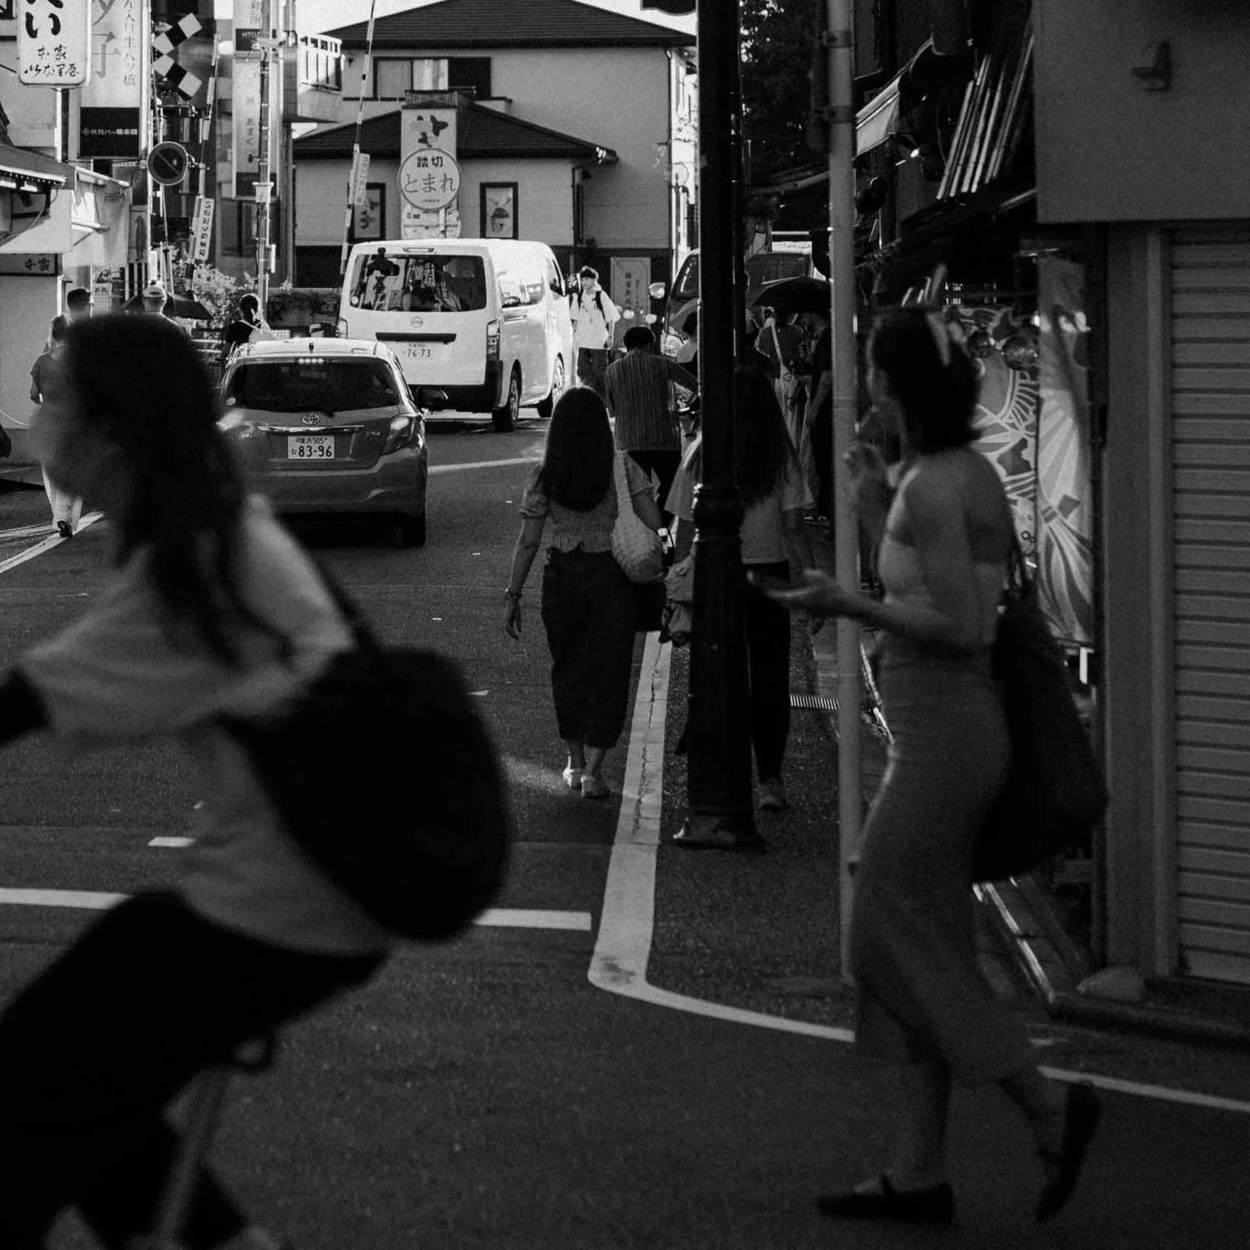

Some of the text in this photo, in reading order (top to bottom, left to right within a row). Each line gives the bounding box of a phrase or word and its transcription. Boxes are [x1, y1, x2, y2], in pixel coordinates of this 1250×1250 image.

[416, 156, 444, 168] 踏切
[404, 173, 457, 193] とまれ
[298, 445, 333, 458] 83-96
